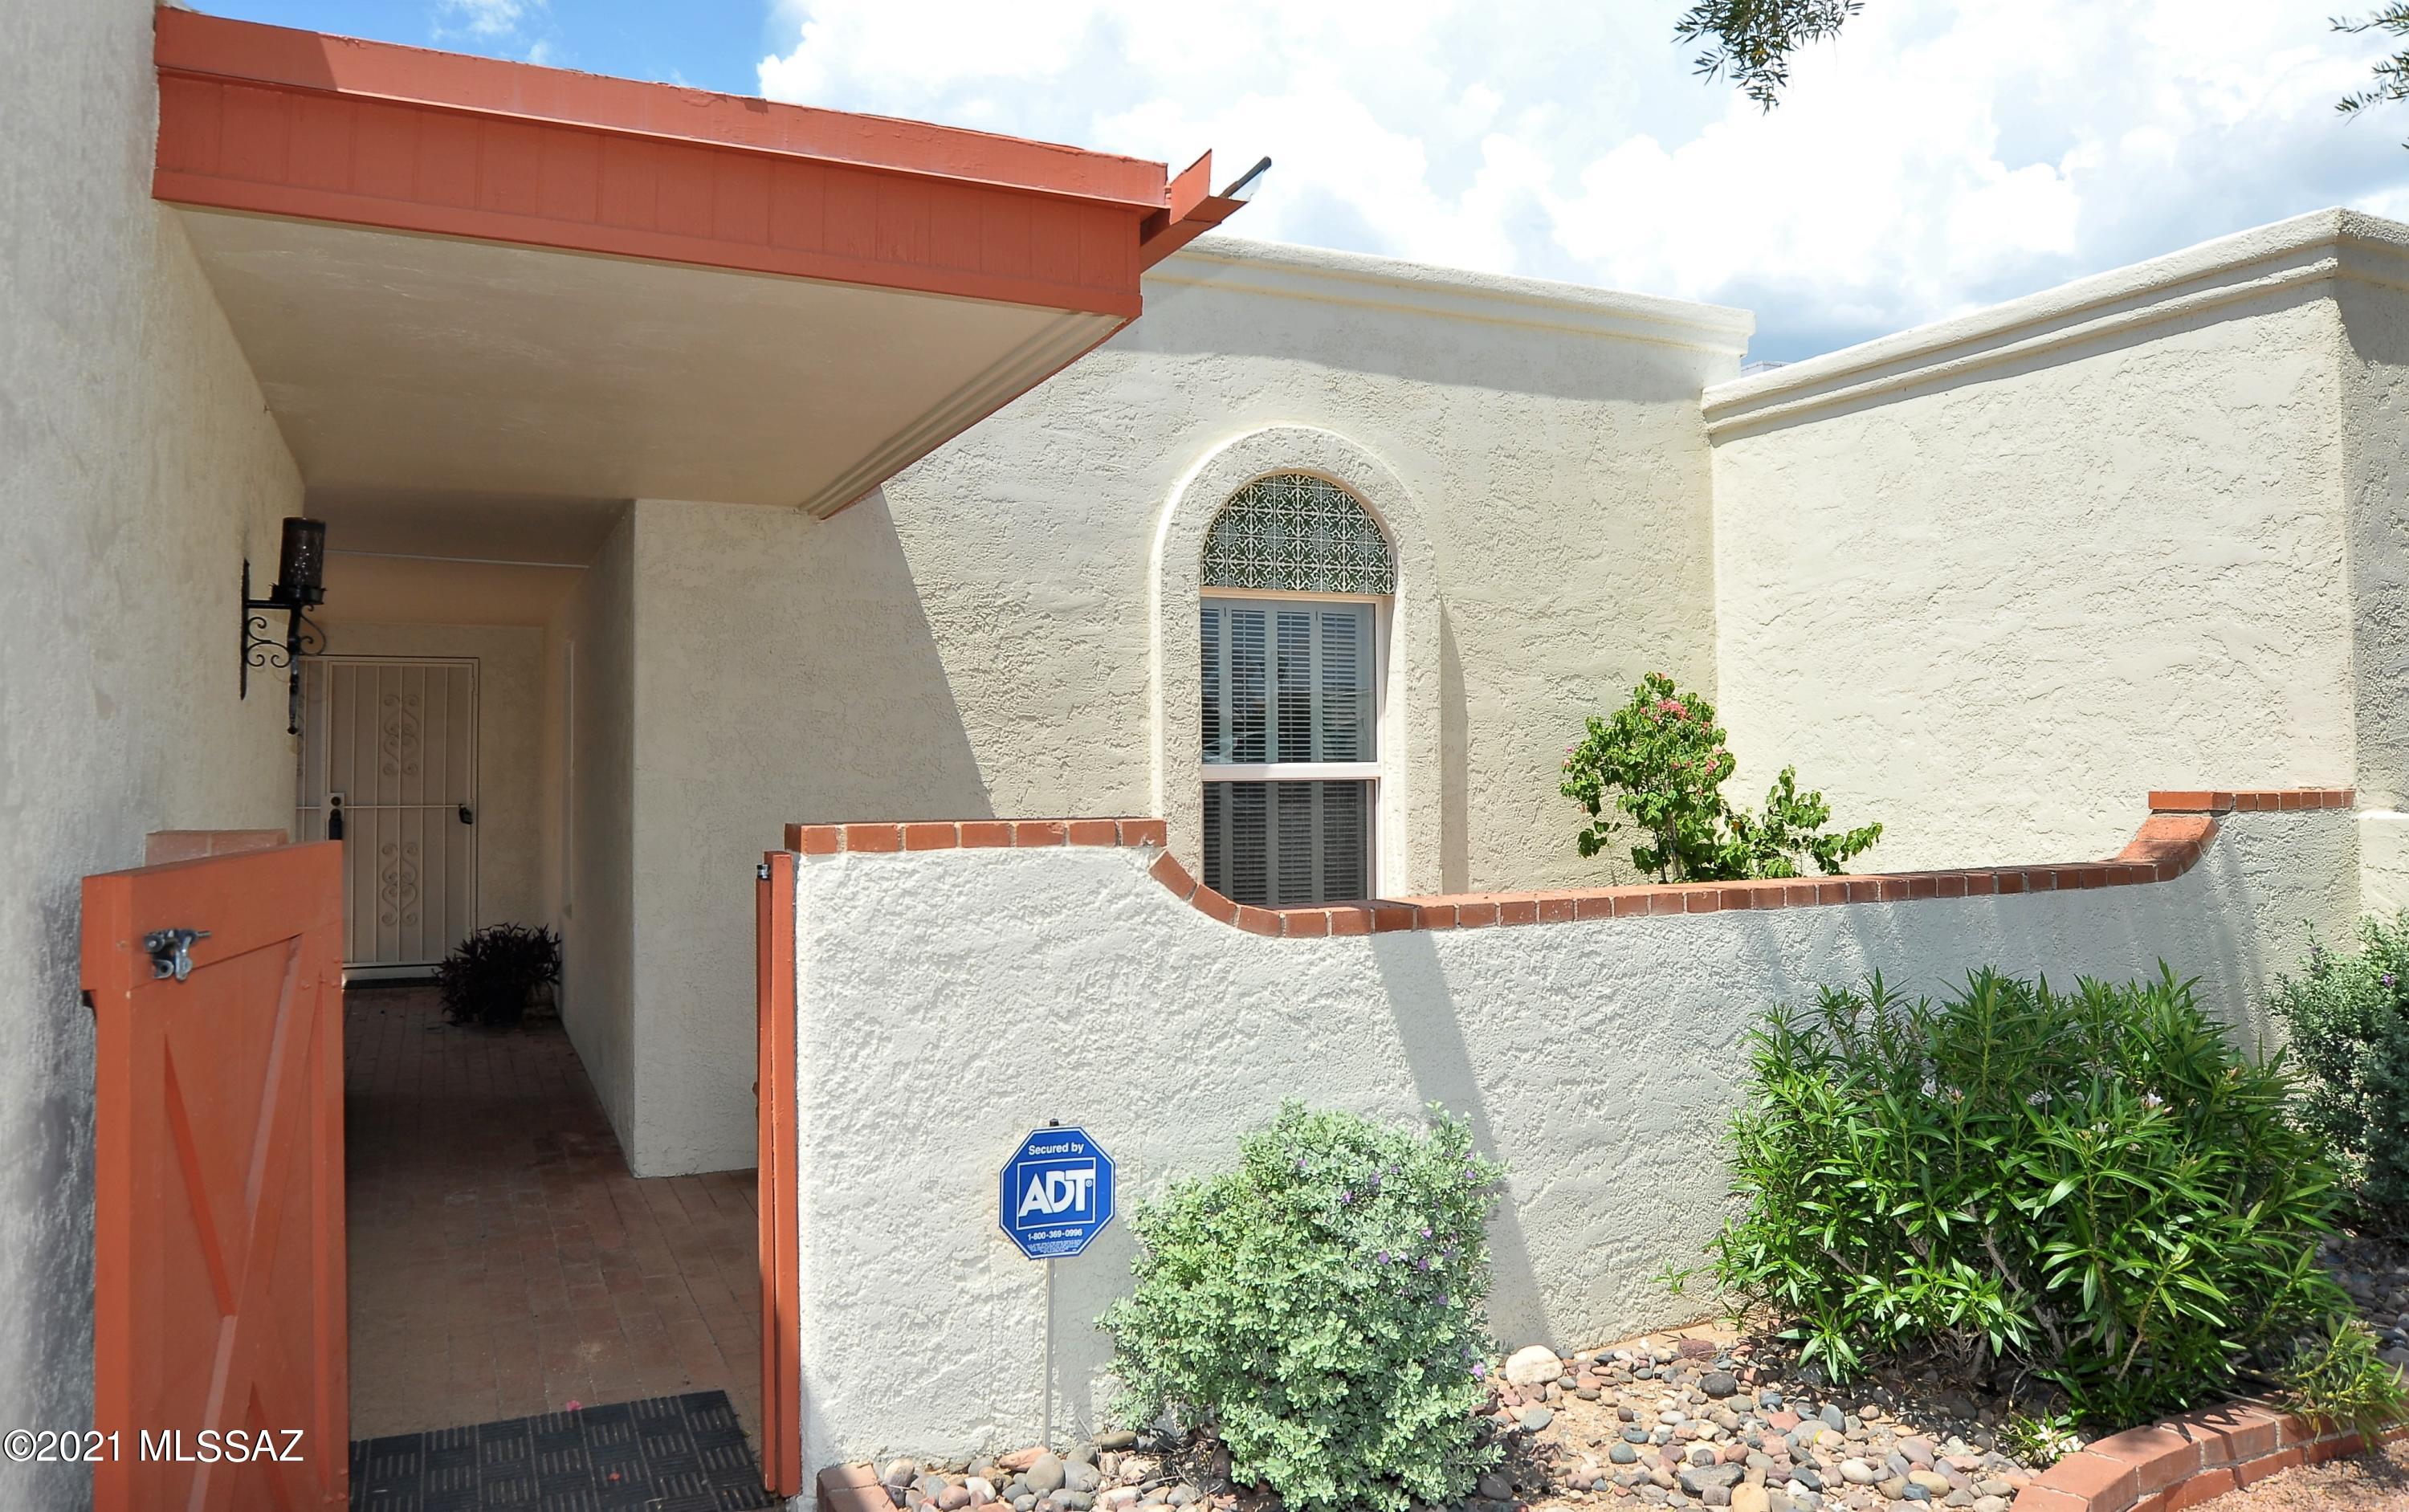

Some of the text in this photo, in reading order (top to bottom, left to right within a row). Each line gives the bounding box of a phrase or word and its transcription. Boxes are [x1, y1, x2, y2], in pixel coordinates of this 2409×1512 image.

[1029, 1142, 1084, 1155] Secured by
[1018, 1169, 1095, 1217] ADT
